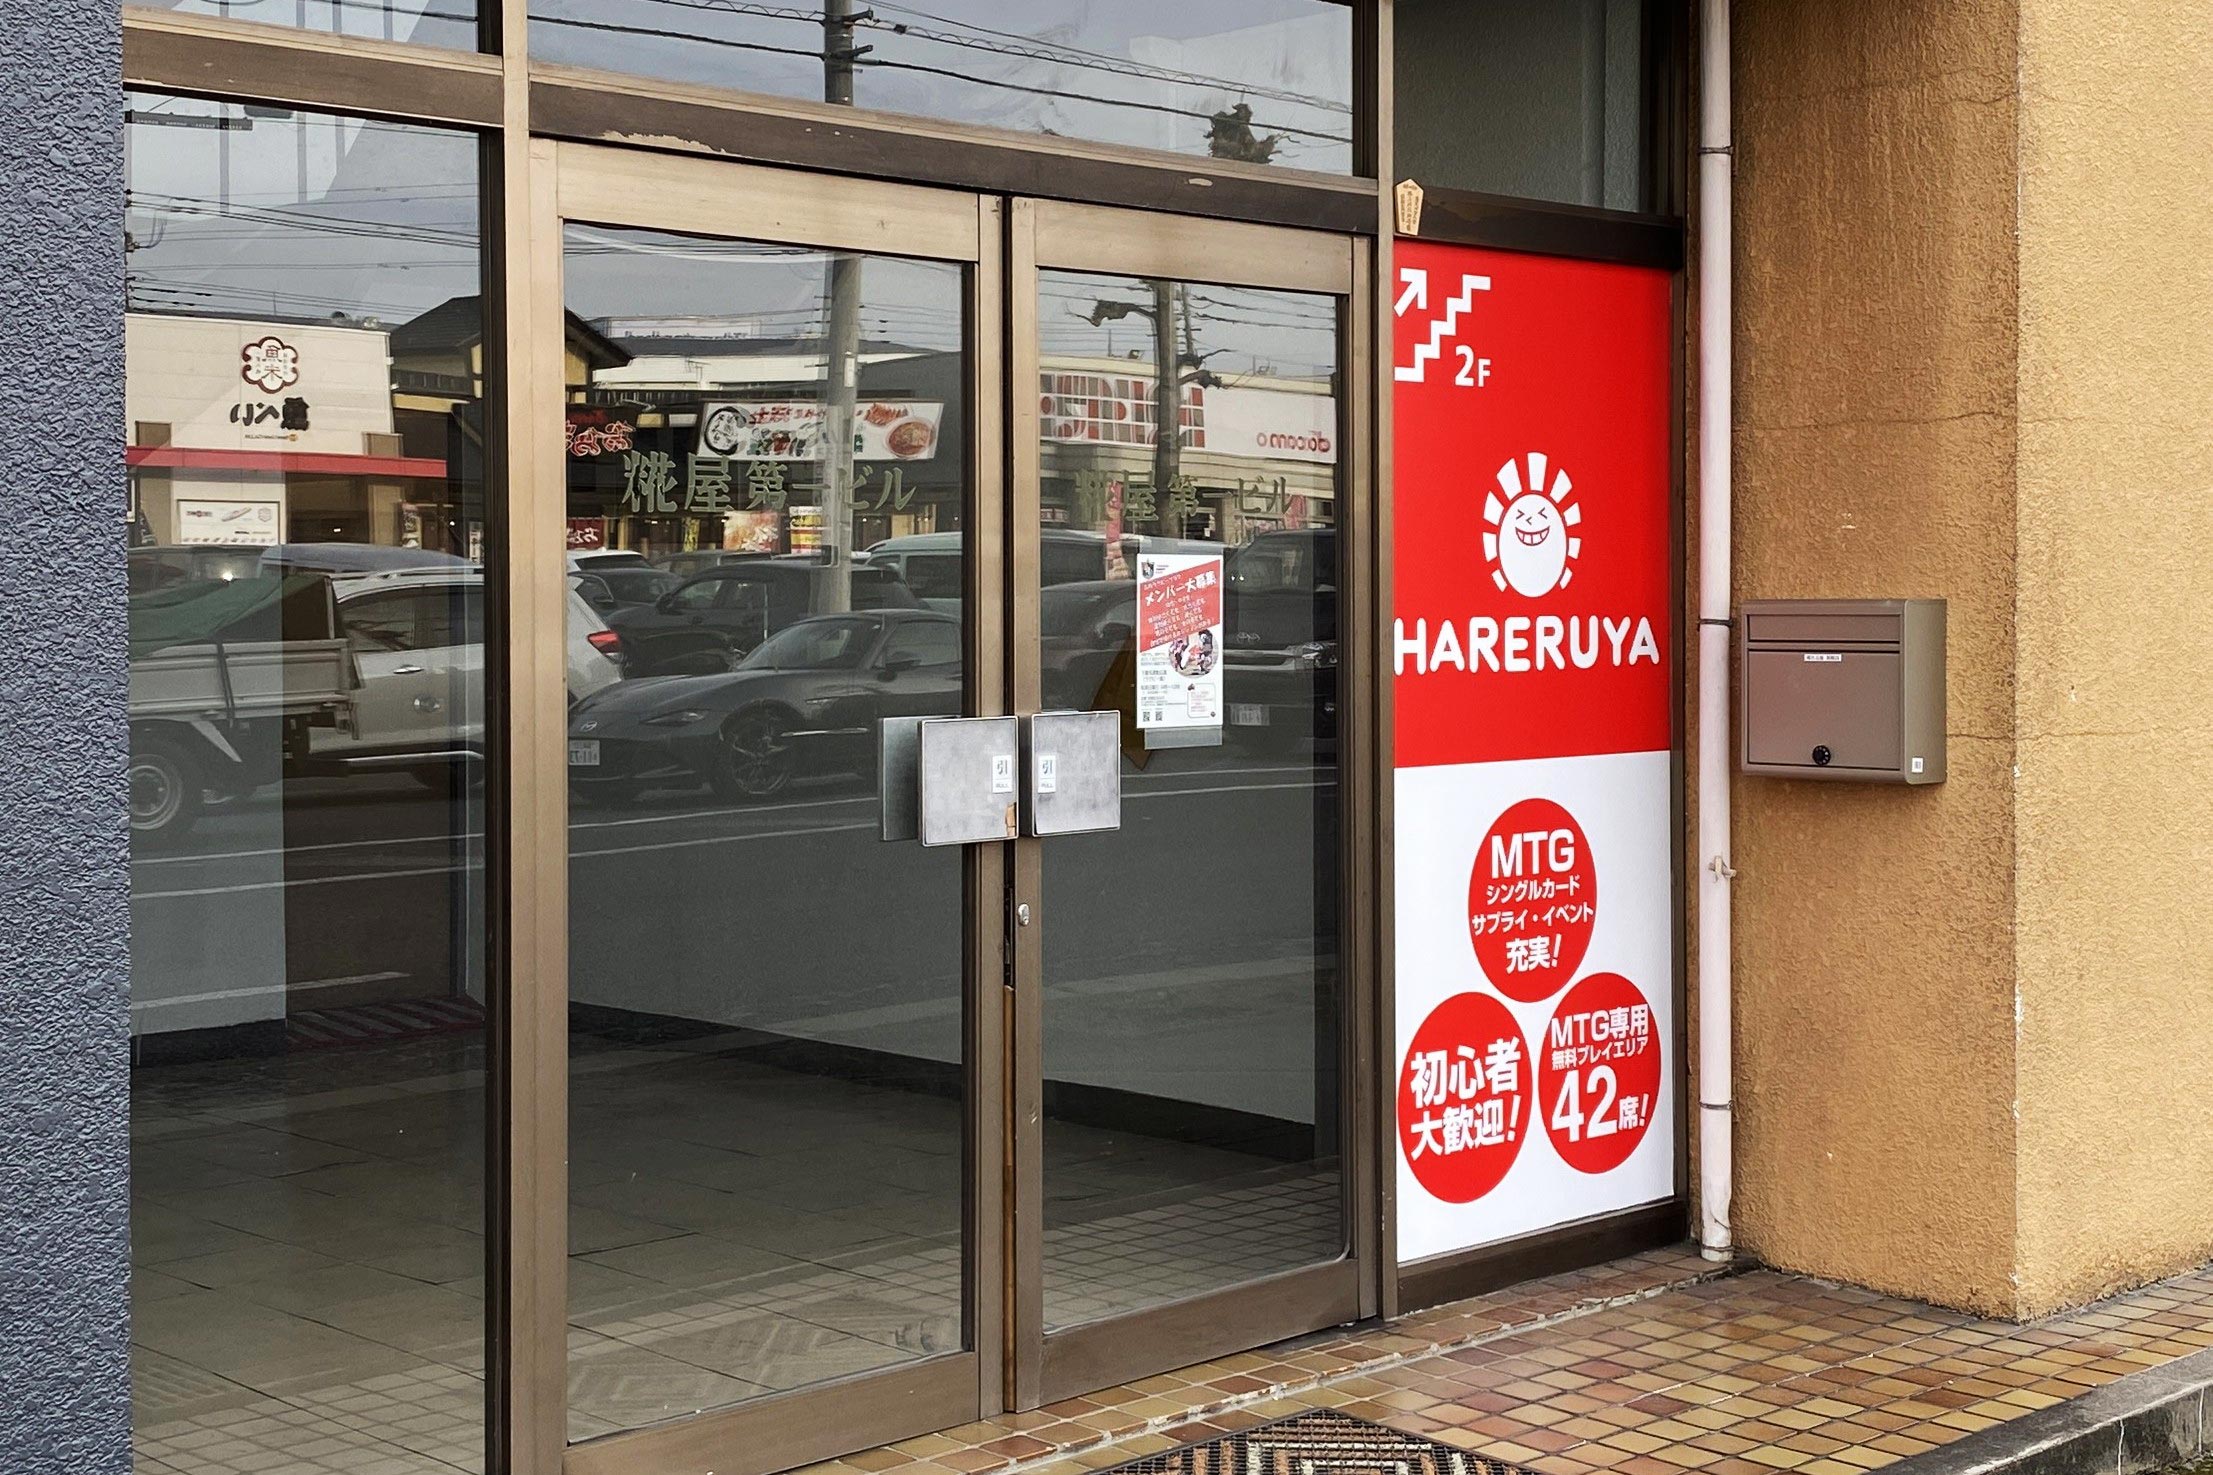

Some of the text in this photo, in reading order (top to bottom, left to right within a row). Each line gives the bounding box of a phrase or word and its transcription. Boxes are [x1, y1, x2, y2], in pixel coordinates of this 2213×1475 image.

[1455, 345, 1491, 387] 2F
[621, 450, 917, 513] 糀屋第一ビル
[1145, 570, 1217, 606] メンバー大募集
[1394, 615, 1660, 676] HARERUYA
[997, 760, 1008, 774] 引
[1042, 760, 1053, 774] 引
[1490, 829, 1575, 879] MTG
[1486, 875, 1580, 905] シングルカード
[1472, 902, 1594, 935] サプライ・イベント
[1506, 934, 1562, 973] 充実!
[1550, 1004, 1648, 1049] MTG専用
[1410, 1038, 1521, 1107] 初心者
[1551, 1037, 1648, 1071] 無料プレイエリア
[1411, 1095, 1522, 1161] 大歓迎!
